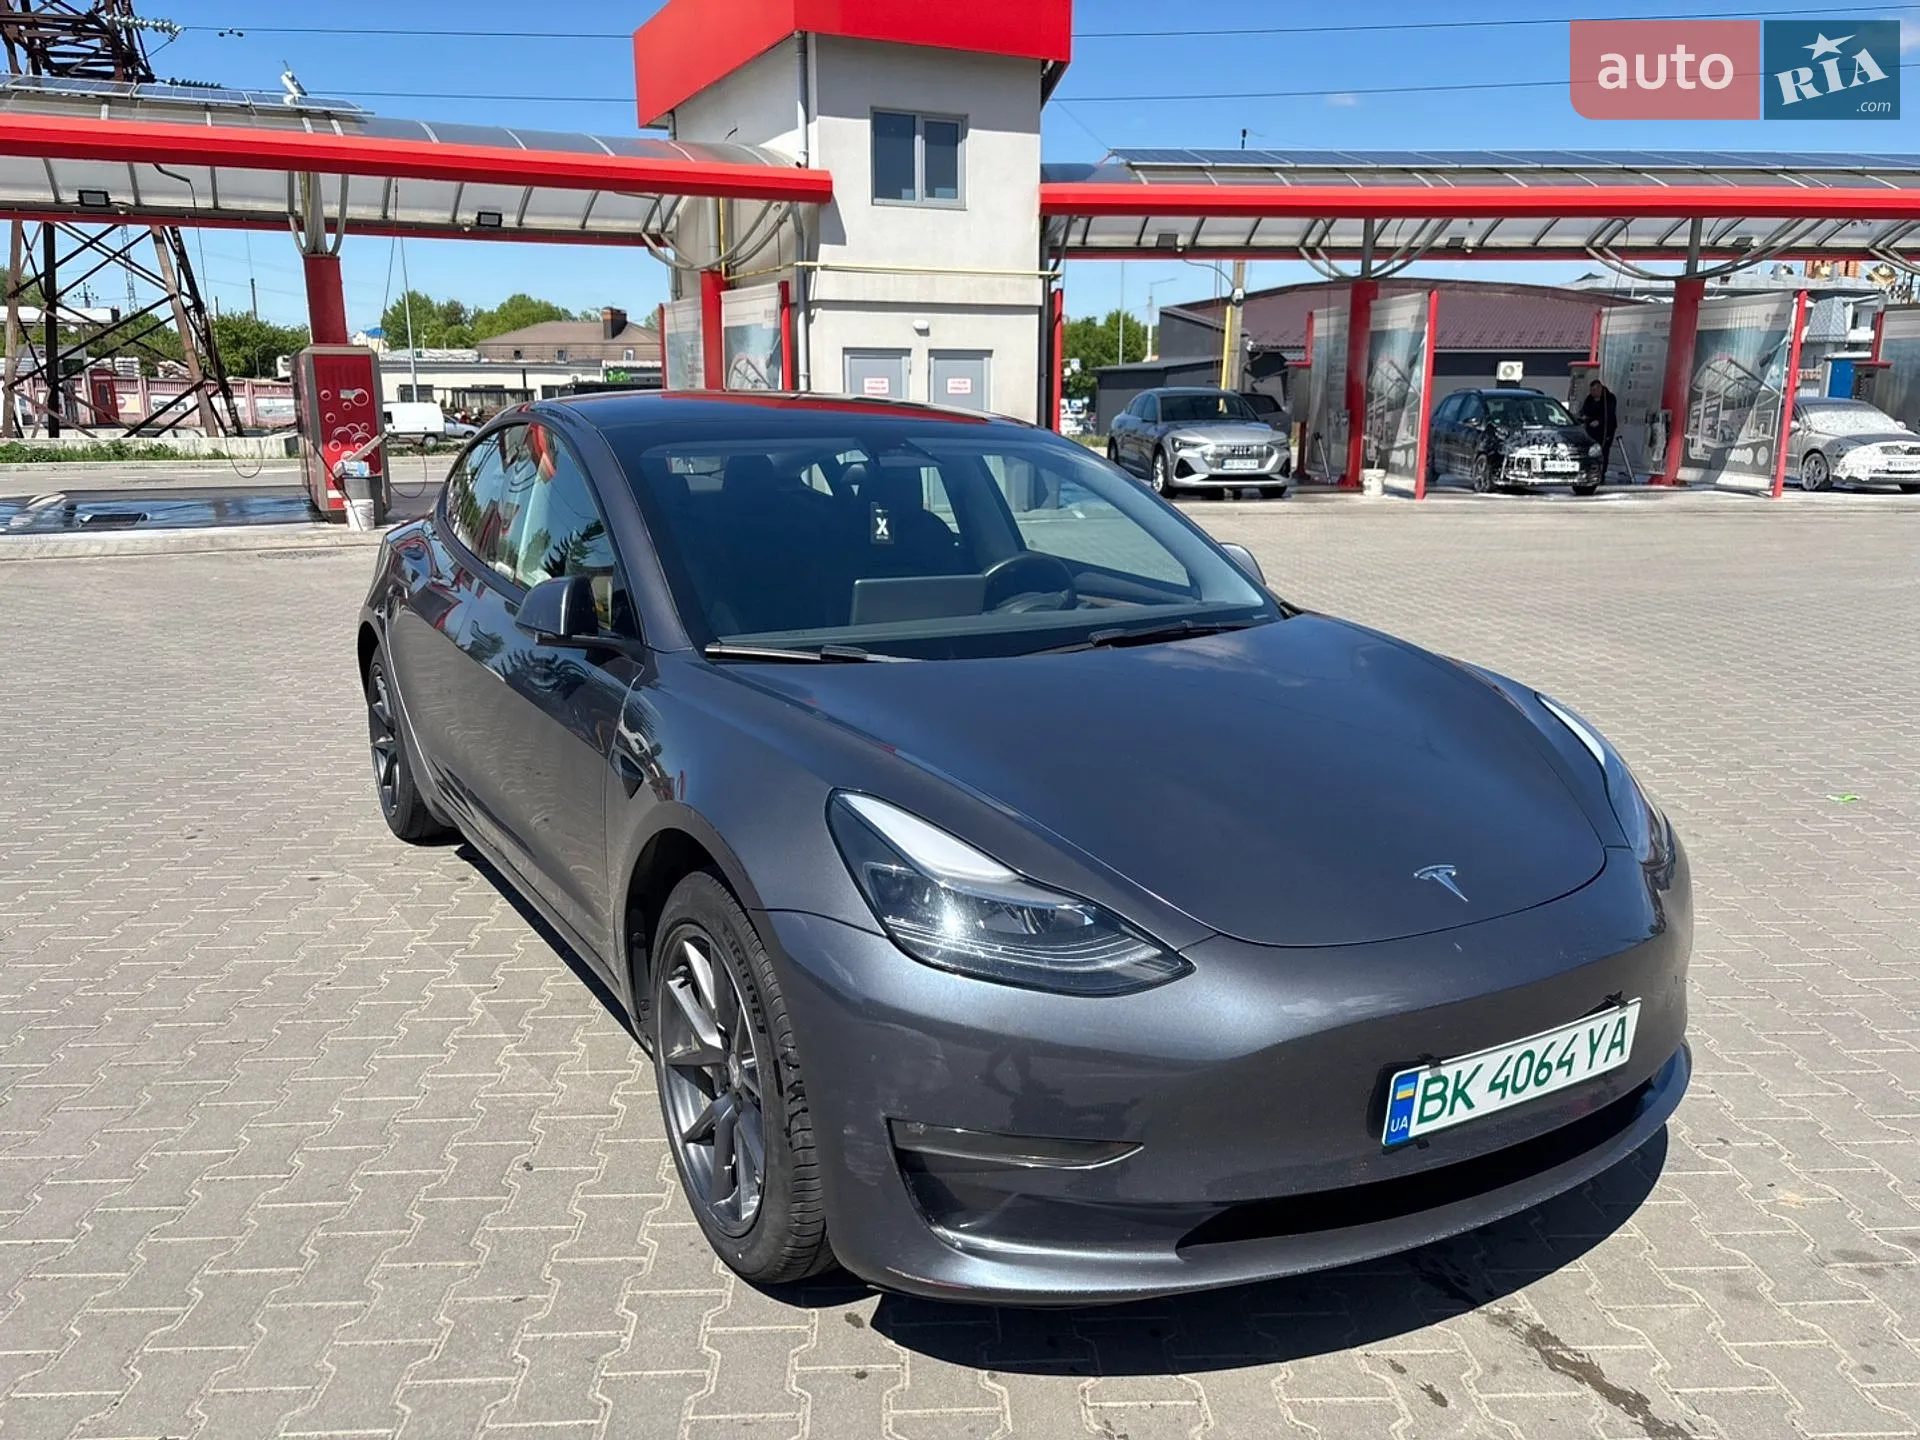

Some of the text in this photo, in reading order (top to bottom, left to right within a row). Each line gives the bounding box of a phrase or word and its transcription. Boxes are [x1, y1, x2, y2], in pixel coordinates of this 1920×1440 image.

[1416, 1014, 1628, 1126] BK 4064 YA
[1390, 1116, 1409, 1133] UA
